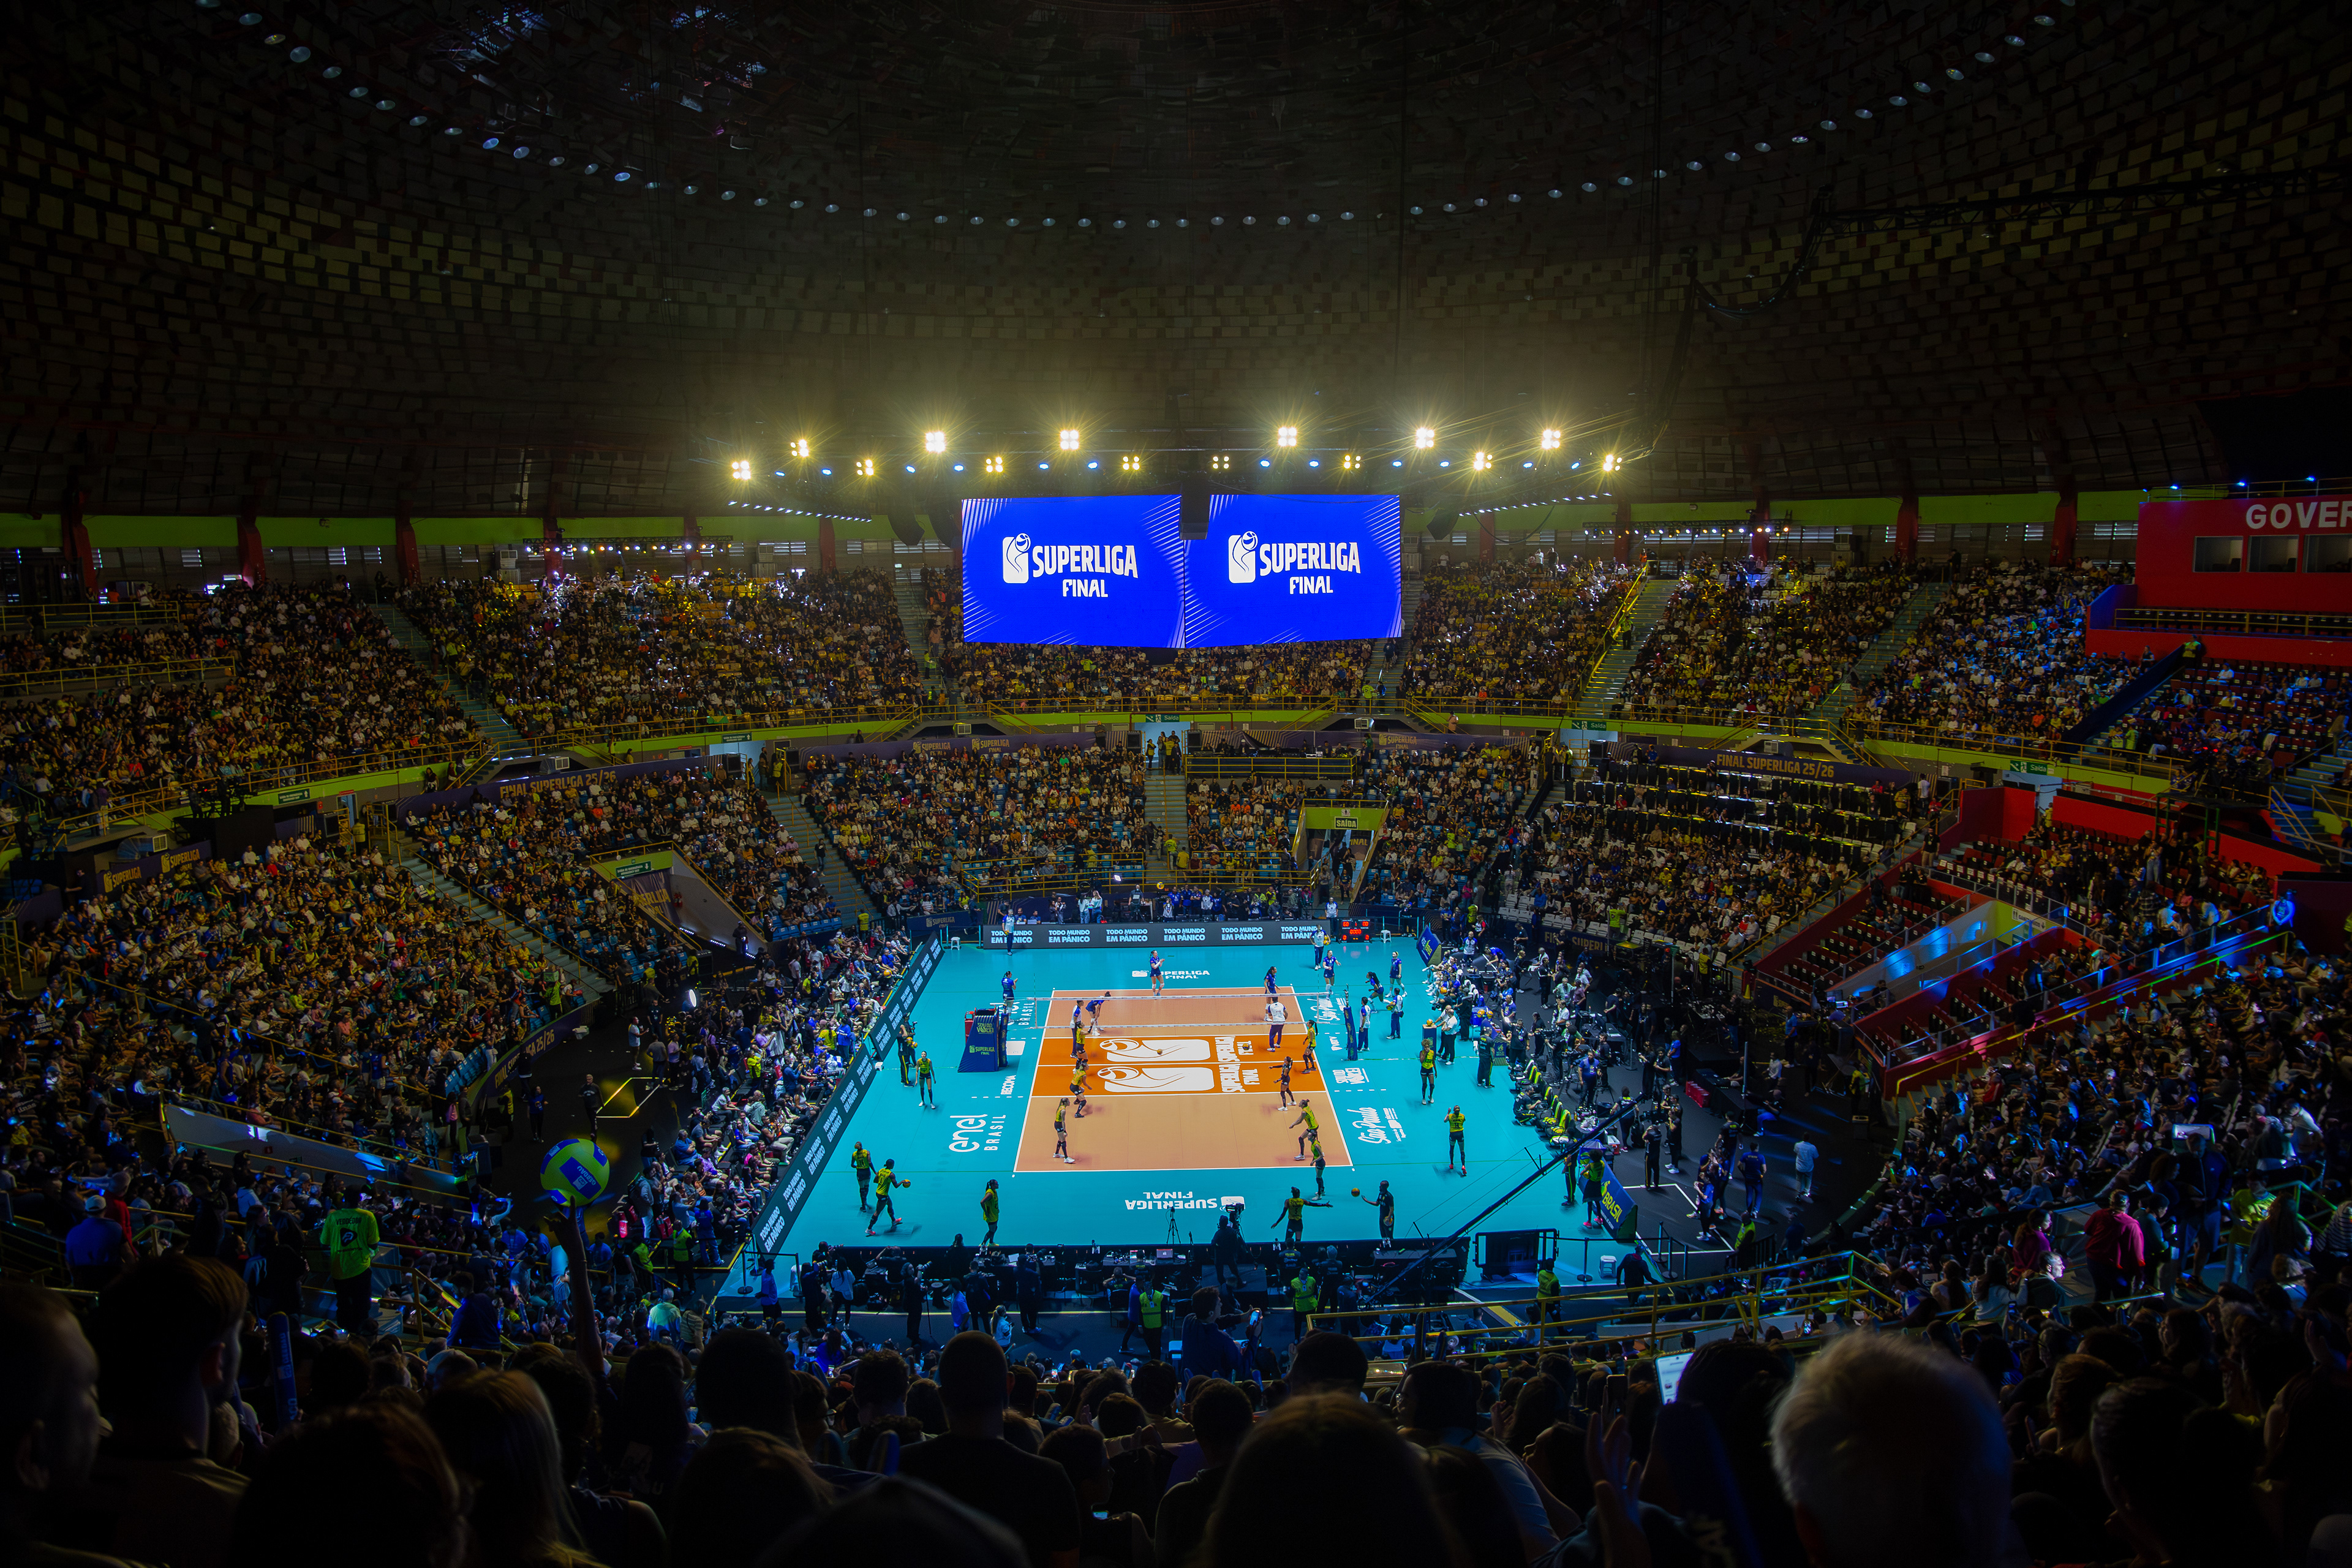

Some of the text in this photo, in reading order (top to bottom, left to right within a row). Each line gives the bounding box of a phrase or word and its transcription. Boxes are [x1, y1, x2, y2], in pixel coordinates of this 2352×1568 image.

[1032, 545, 1138, 578] SUPERLIGA
[1260, 542, 1361, 576] SUPERLIGA
[1063, 579, 1108, 597] FINAL
[1290, 576, 1333, 594] FINAL
[922, 742, 951, 751] SUPERLIGA
[980, 738, 1010, 748] SUPERLIGA
[1388, 736, 1417, 744] SUPERLIGA
[1717, 754, 1834, 779] FINAL SUPERLIGA 25/26
[1336, 819, 1356, 827] SAÍDA
[170, 849, 200, 868] SUPERLIGA
[112, 866, 141, 888] SUPERLIGA
[536, 1029, 555, 1053] 25/26
[1219, 1064, 1246, 1092] SUPERLIGA
[949, 1114, 988, 1152] enel
[984, 1115, 1006, 1150] BRASIL
[811, 1137, 820, 1153] MUNDO
[809, 1162, 816, 1175] EM
[783, 1170, 801, 1200] TODO MUNDO
[788, 1198, 795, 1212] EM
[1125, 1198, 1217, 1210] SUPERLIGA
[1602, 1191, 1623, 1223] BRASIL
[760, 1207, 779, 1240] TODO MUNDO
[764, 1216, 784, 1253] EM PÂNICO
